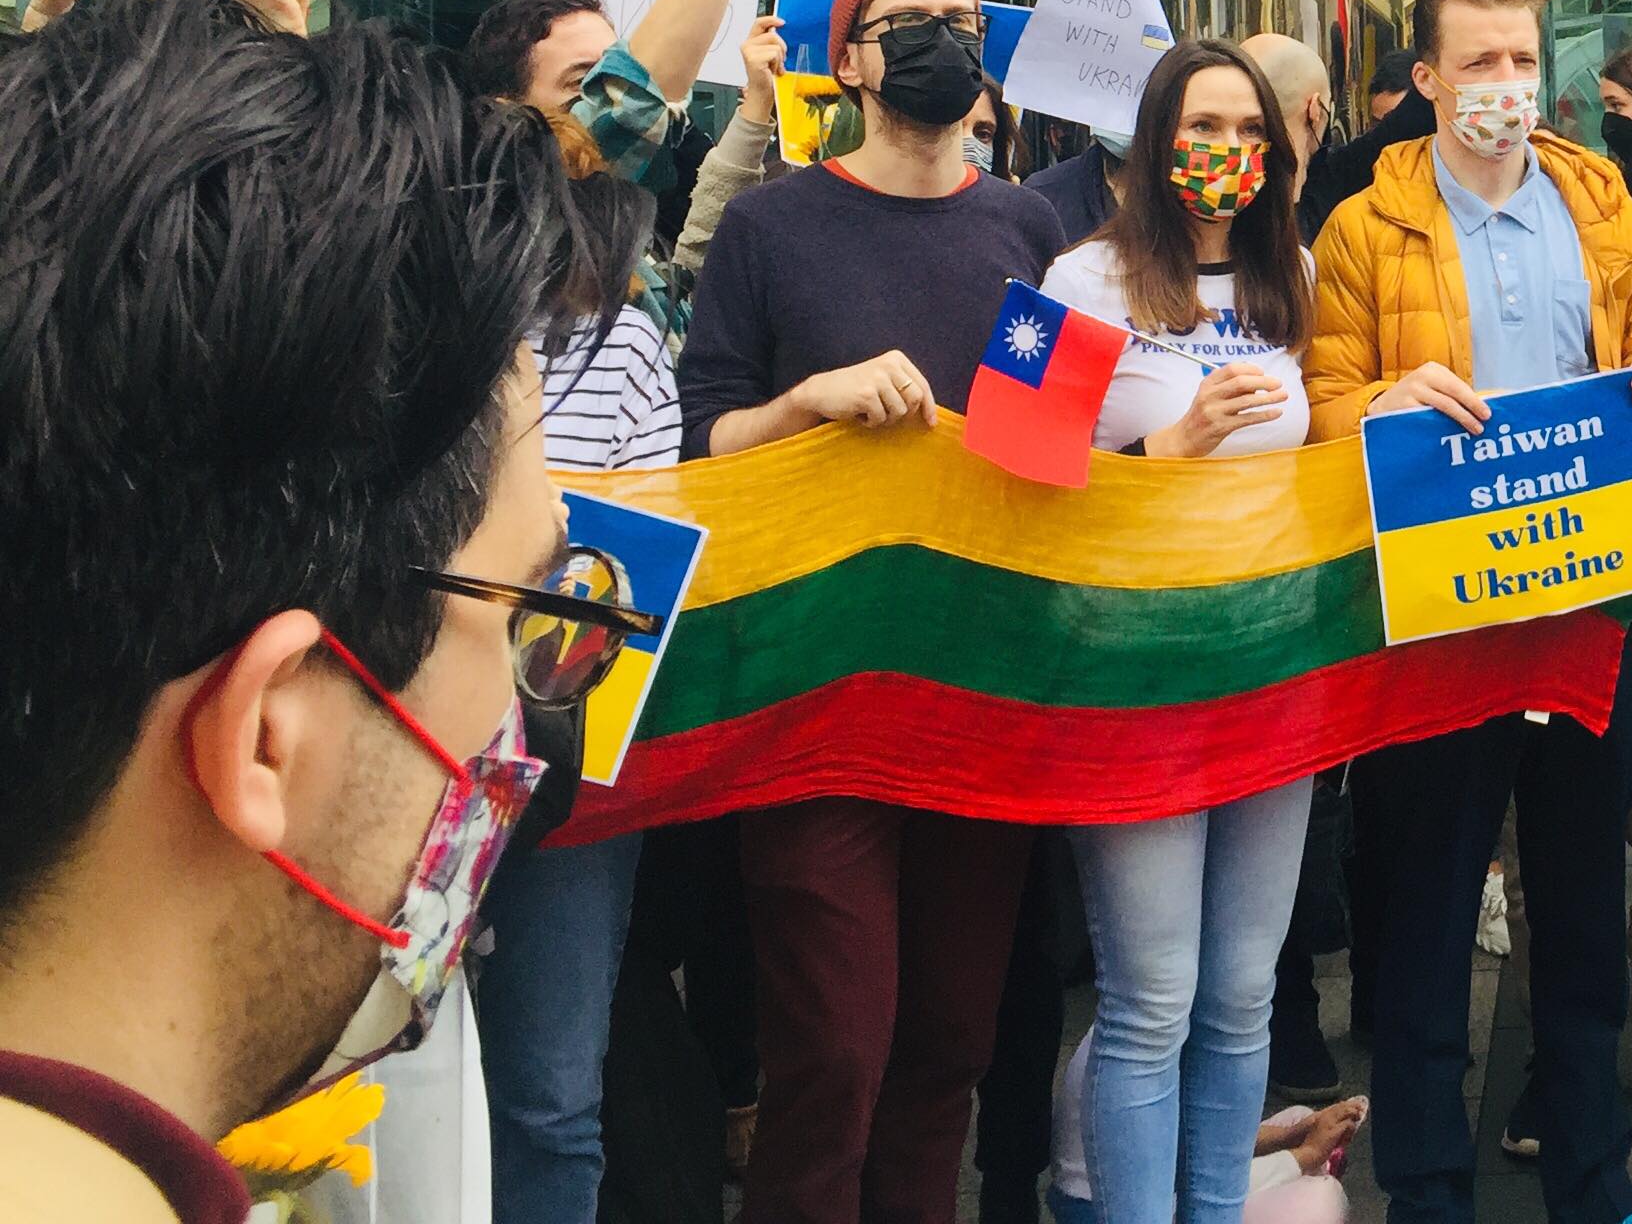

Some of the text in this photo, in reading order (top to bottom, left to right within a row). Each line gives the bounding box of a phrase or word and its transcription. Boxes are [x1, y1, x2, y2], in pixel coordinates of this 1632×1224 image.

[1065, 21, 1119, 54] WITH
[1192, 343, 1222, 356] FOR
[1440, 414, 1605, 466] Taiwan
[1470, 455, 1590, 510] stand
[1486, 506, 1585, 551] with
[1452, 549, 1625, 604] Ukraine
